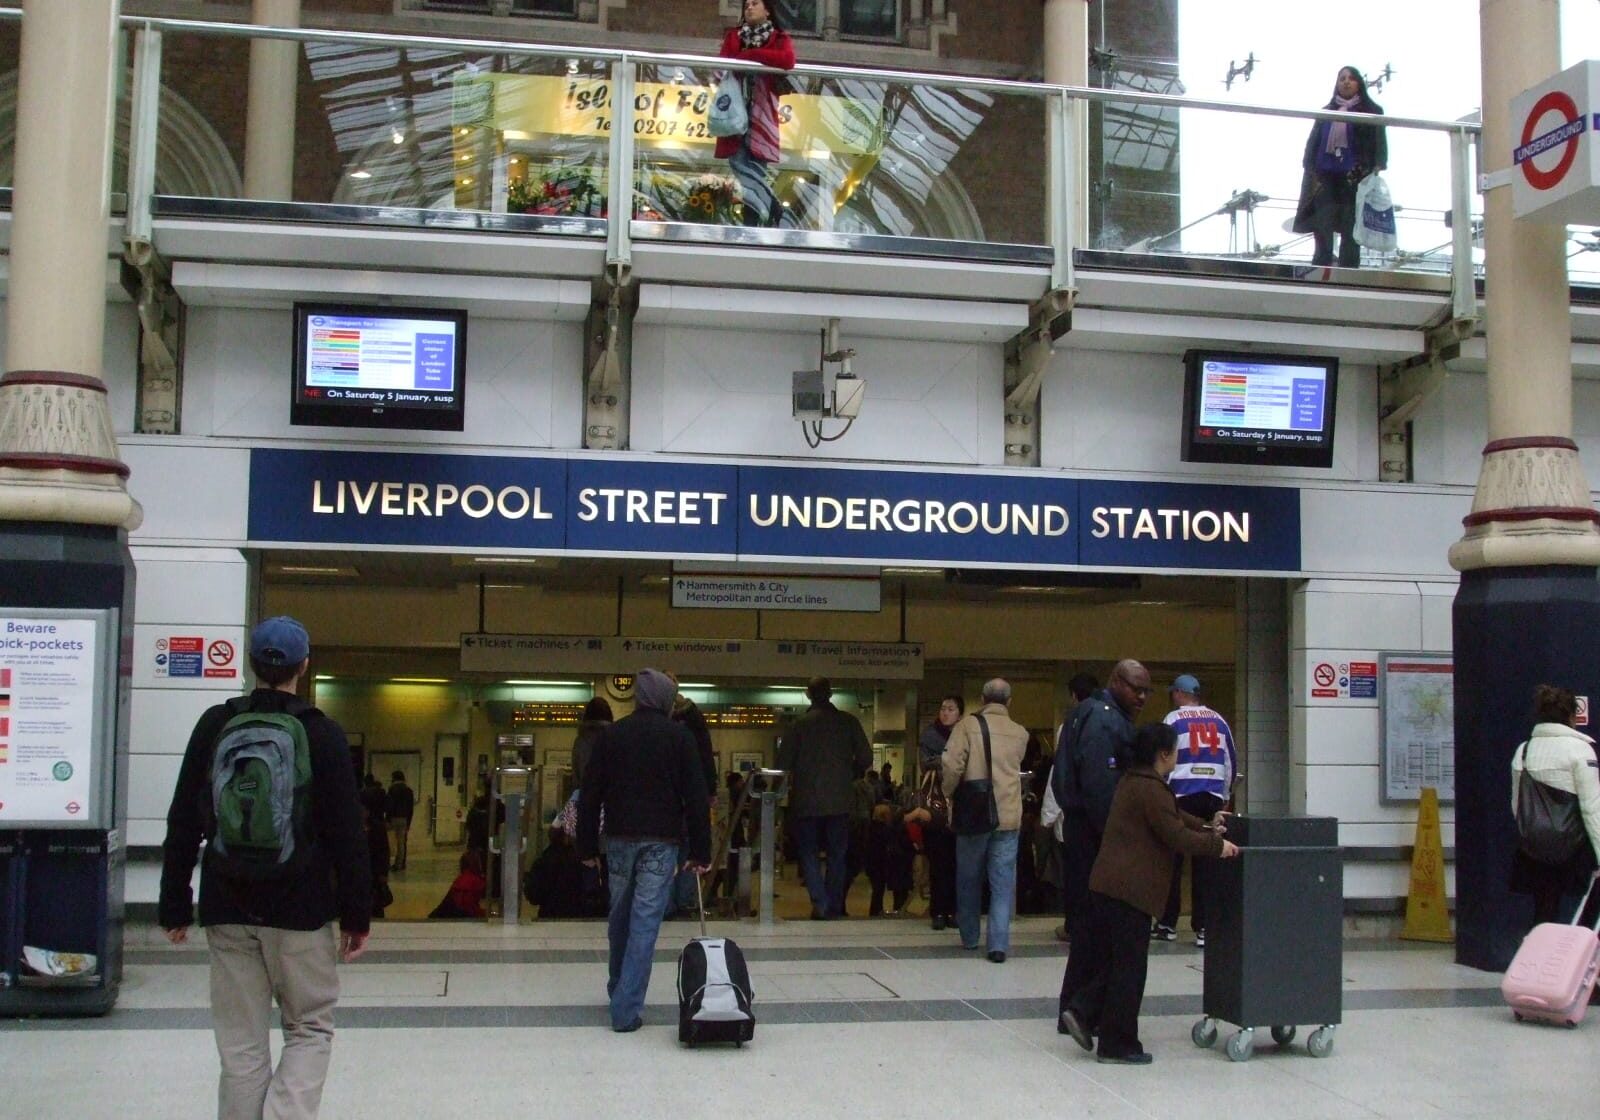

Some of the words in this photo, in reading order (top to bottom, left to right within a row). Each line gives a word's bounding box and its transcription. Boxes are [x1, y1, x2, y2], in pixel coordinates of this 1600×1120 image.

[634, 88, 665, 118] of
[596, 116, 611, 131] Te
[633, 118, 678, 136] 0207
[685, 121, 713, 138] 42
[1517, 121, 1583, 160] UNDERGROUND
[327, 390, 342, 398] On
[345, 390, 385, 400] Saturday
[395, 393, 432, 402] January,
[1217, 429, 1230, 437] On
[1232, 430, 1267, 440] Saturday
[1274, 433, 1304, 442] January,
[312, 479, 553, 519] LIVERPOOL
[577, 487, 728, 525] STREET
[749, 493, 1070, 537] UNDERGROUND
[1091, 506, 1250, 542] STATION
[686, 580, 756, 592] Hammersmith
[759, 582, 767, 591] &
[768, 581, 789, 593] City
[686, 591, 751, 604] Metropolitan
[753, 593, 772, 603] and
[775, 594, 802, 604] Circle
[805, 594, 828, 605] lines
[7, 622, 57, 634] Beware
[478, 637, 512, 649] Ticket
[516, 639, 570, 650] machines
[635, 640, 669, 652] Ticket
[673, 642, 722, 653] windows
[811, 644, 842, 655] Travel
[847, 645, 910, 657] Information
[1189, 722, 1220, 755] 14
